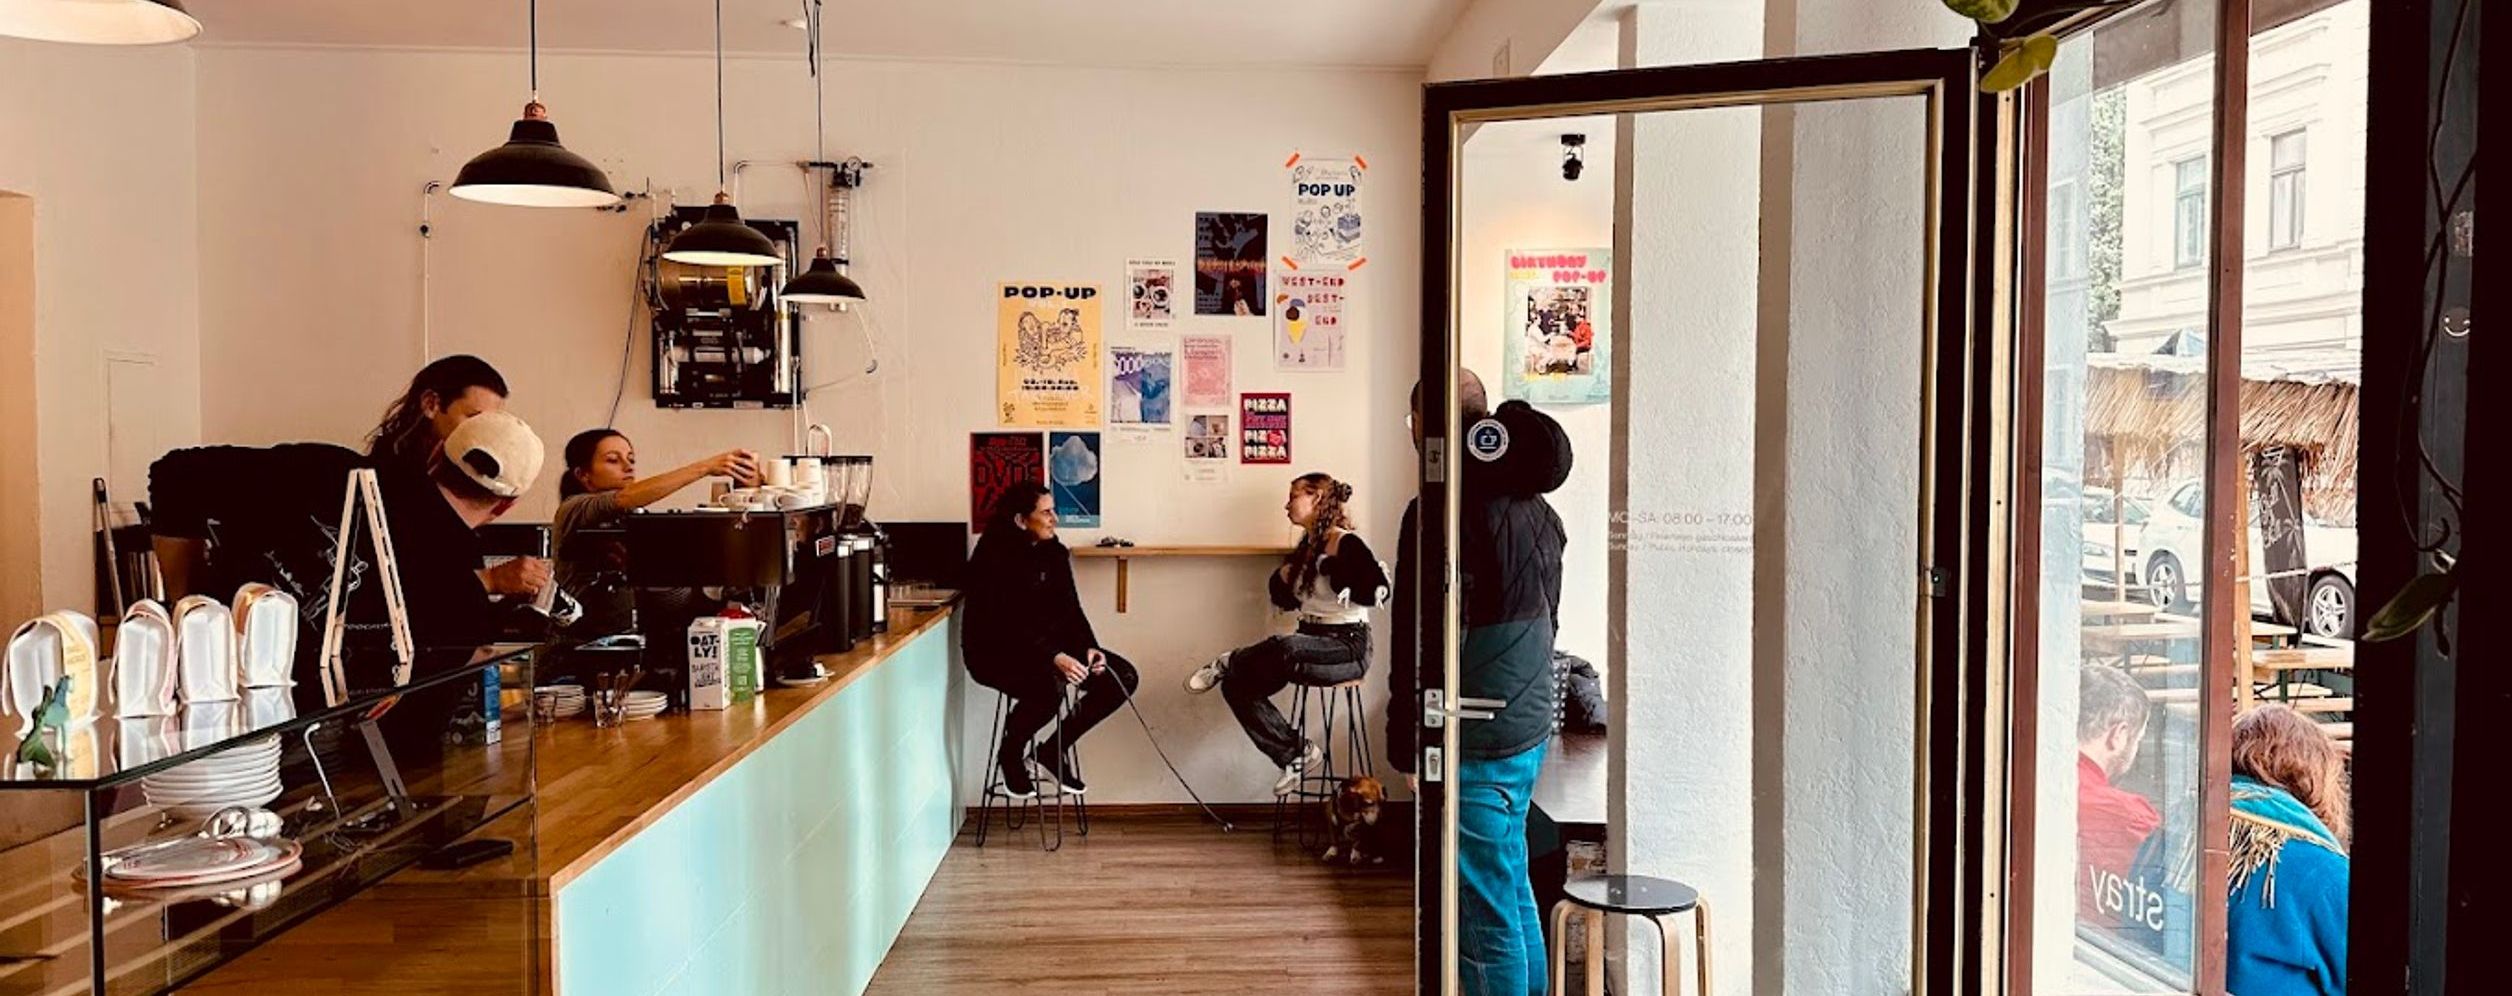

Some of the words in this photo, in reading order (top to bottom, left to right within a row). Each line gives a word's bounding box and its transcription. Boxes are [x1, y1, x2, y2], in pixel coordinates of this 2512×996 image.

[1298, 184, 1331, 196] POP
[1335, 184, 1355, 196] UP
[1511, 256, 1586, 268] BIRTHDAY
[1282, 276, 1344, 286] WEST-END
[1004, 286, 1096, 299] POP-UP
[1244, 398, 1287, 412] PIZZA
[1244, 445, 1287, 459] PIZZA
[690, 634, 720, 646] OAT-
[694, 646, 717, 658] LY!
